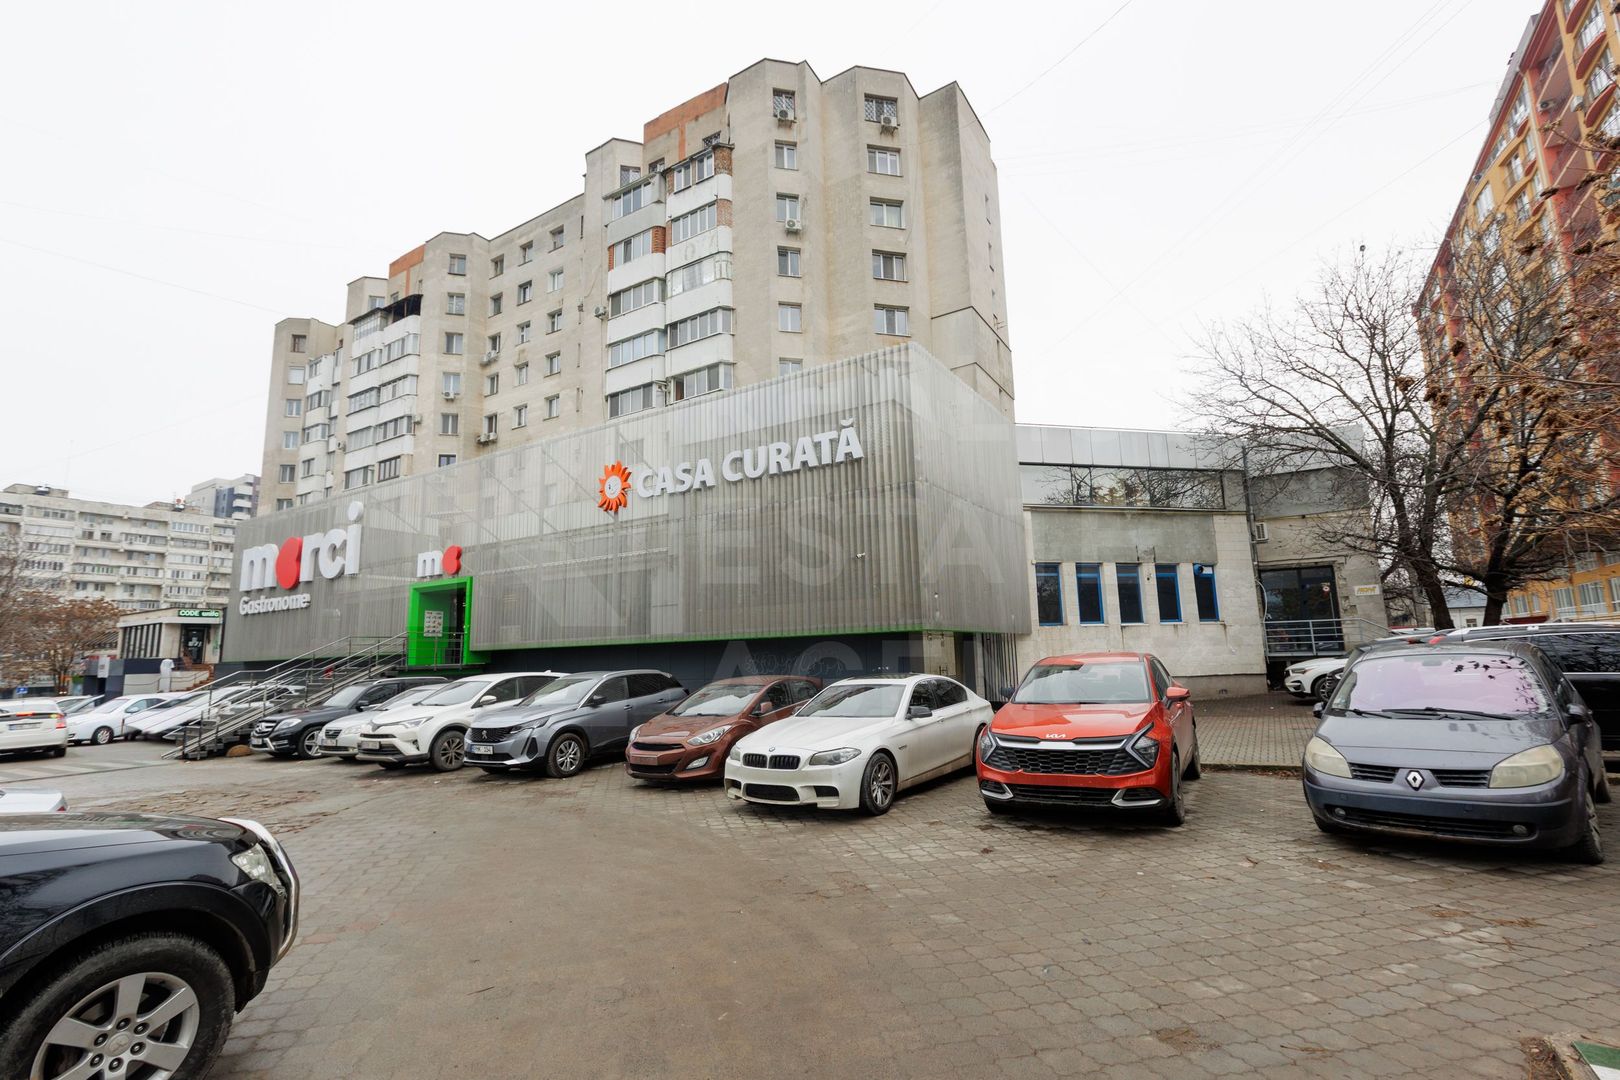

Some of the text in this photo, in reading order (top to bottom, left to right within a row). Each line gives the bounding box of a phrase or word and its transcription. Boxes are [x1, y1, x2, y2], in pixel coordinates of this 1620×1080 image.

[637, 418, 864, 498] CASA CURATĂ
[240, 593, 311, 616] Gastronome
